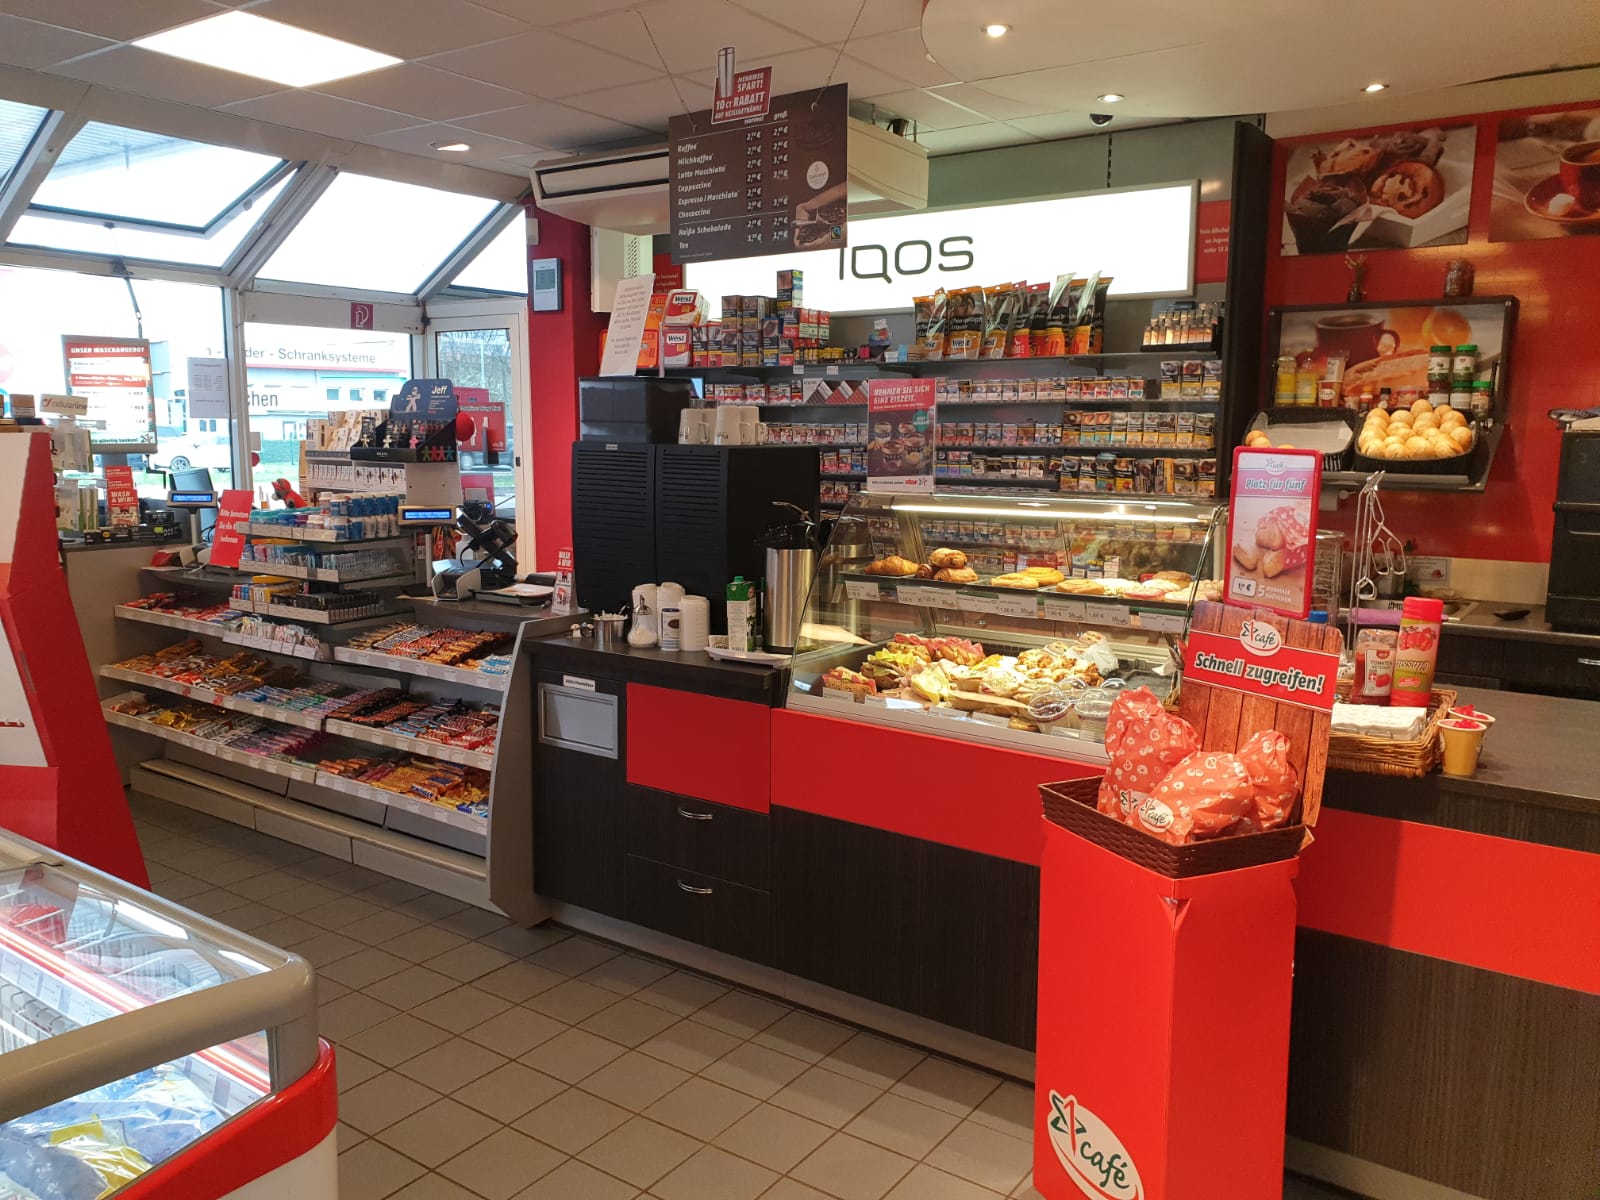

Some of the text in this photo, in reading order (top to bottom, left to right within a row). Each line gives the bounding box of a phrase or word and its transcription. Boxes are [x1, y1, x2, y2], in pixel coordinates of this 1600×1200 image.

[738, 80, 764, 92] SPART!
[716, 100, 724, 110] 10
[734, 92, 766, 106] RABATT
[839, 236, 974, 284] IQOS
[246, 346, 265, 358] der
[278, 347, 376, 364] Schranksysteme
[248, 388, 278, 408] chen
[432, 386, 448, 394] Jeff
[874, 386, 902, 396] NEHMEN
[914, 384, 930, 392] SICH
[874, 396, 888, 404] EINE
[1246, 479, 1305, 492] Platz für fünf
[1258, 585, 1265, 597] 5
[1255, 632, 1276, 648] café
[1196, 653, 1324, 693] Schnell zugreifen!
[1080, 1141, 1130, 1188] café
